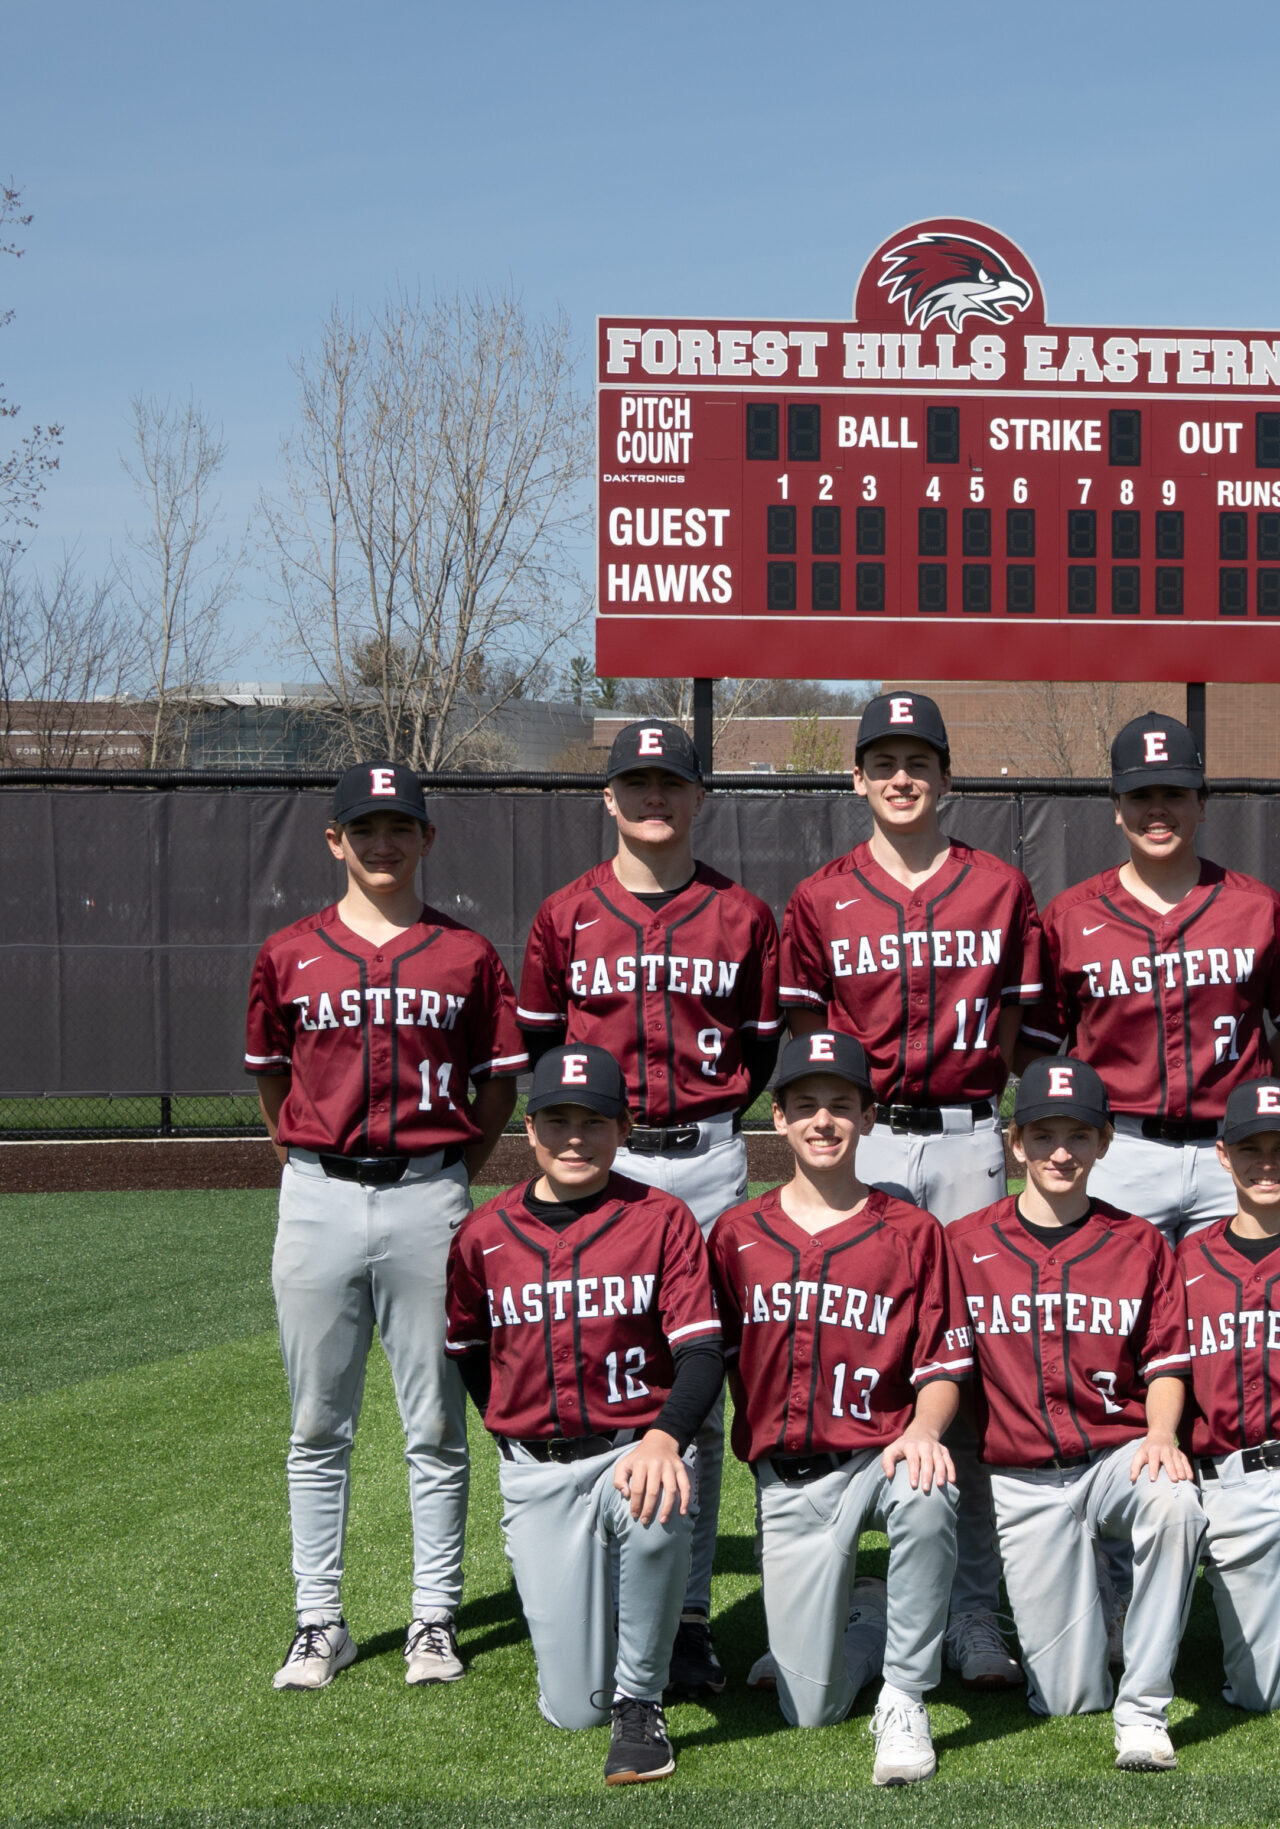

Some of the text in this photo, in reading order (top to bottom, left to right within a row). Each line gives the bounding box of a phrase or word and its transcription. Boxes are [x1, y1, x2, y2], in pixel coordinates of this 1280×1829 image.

[607, 328, 828, 377] FOREST
[843, 332, 1006, 381] HILLS
[621, 397, 691, 430] PITCH
[616, 430, 693, 464] COUNT
[838, 416, 918, 448] BALL
[989, 418, 1102, 451] STRIKE
[1179, 422, 1243, 454] OUT
[603, 474, 686, 484] DAKTRONICS
[777, 474, 788, 500] 1
[818, 475, 833, 501] 2
[862, 475, 877, 502] 3
[926, 476, 941, 502] 4
[969, 477, 985, 503] 5
[1013, 478, 1028, 504] 6
[1077, 478, 1092, 505] 7
[1119, 479, 1134, 505] 8
[1162, 480, 1176, 506] 9
[608, 507, 730, 546] GUEST
[608, 564, 733, 603] HAWKS
[889, 698, 914, 724] E
[637, 727, 664, 756] E
[1143, 731, 1169, 763] E
[370, 768, 397, 797] E
[829, 928, 1002, 977] EASTERN
[570, 953, 740, 998] EASTERN
[1082, 948, 1256, 998] EASTERN
[292, 987, 466, 1031] EASTERN
[953, 998, 990, 1050] 17
[697, 1027, 722, 1077] 9
[809, 1034, 836, 1062] E
[418, 1059, 457, 1111] 14
[561, 1053, 588, 1084] E
[1048, 1067, 1074, 1097] E
[743, 1280, 894, 1336] ASTERN
[966, 1292, 1143, 1337] EASTERN
[944, 1325, 974, 1351] FH
[605, 1346, 650, 1404] 12
[832, 1362, 881, 1422] 13
